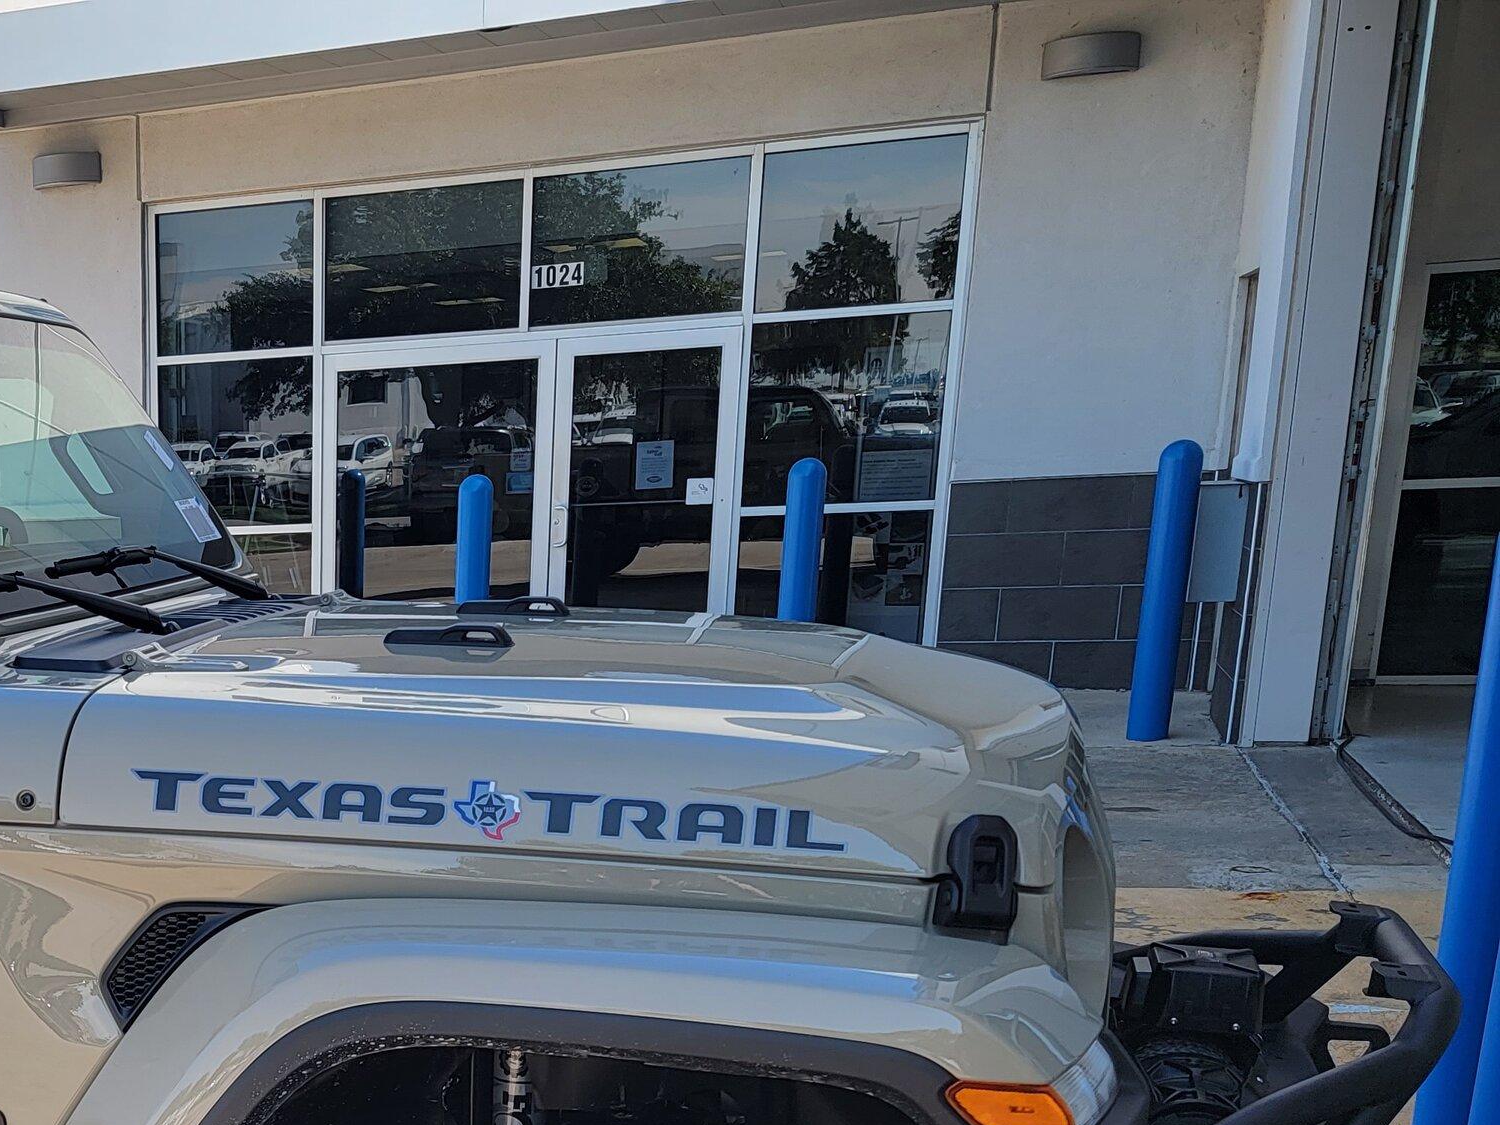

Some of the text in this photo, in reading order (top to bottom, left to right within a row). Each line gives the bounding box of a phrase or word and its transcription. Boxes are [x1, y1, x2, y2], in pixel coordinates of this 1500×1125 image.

[535, 263, 583, 288] 1024
[132, 769, 846, 852] TEXAS TRAIL
